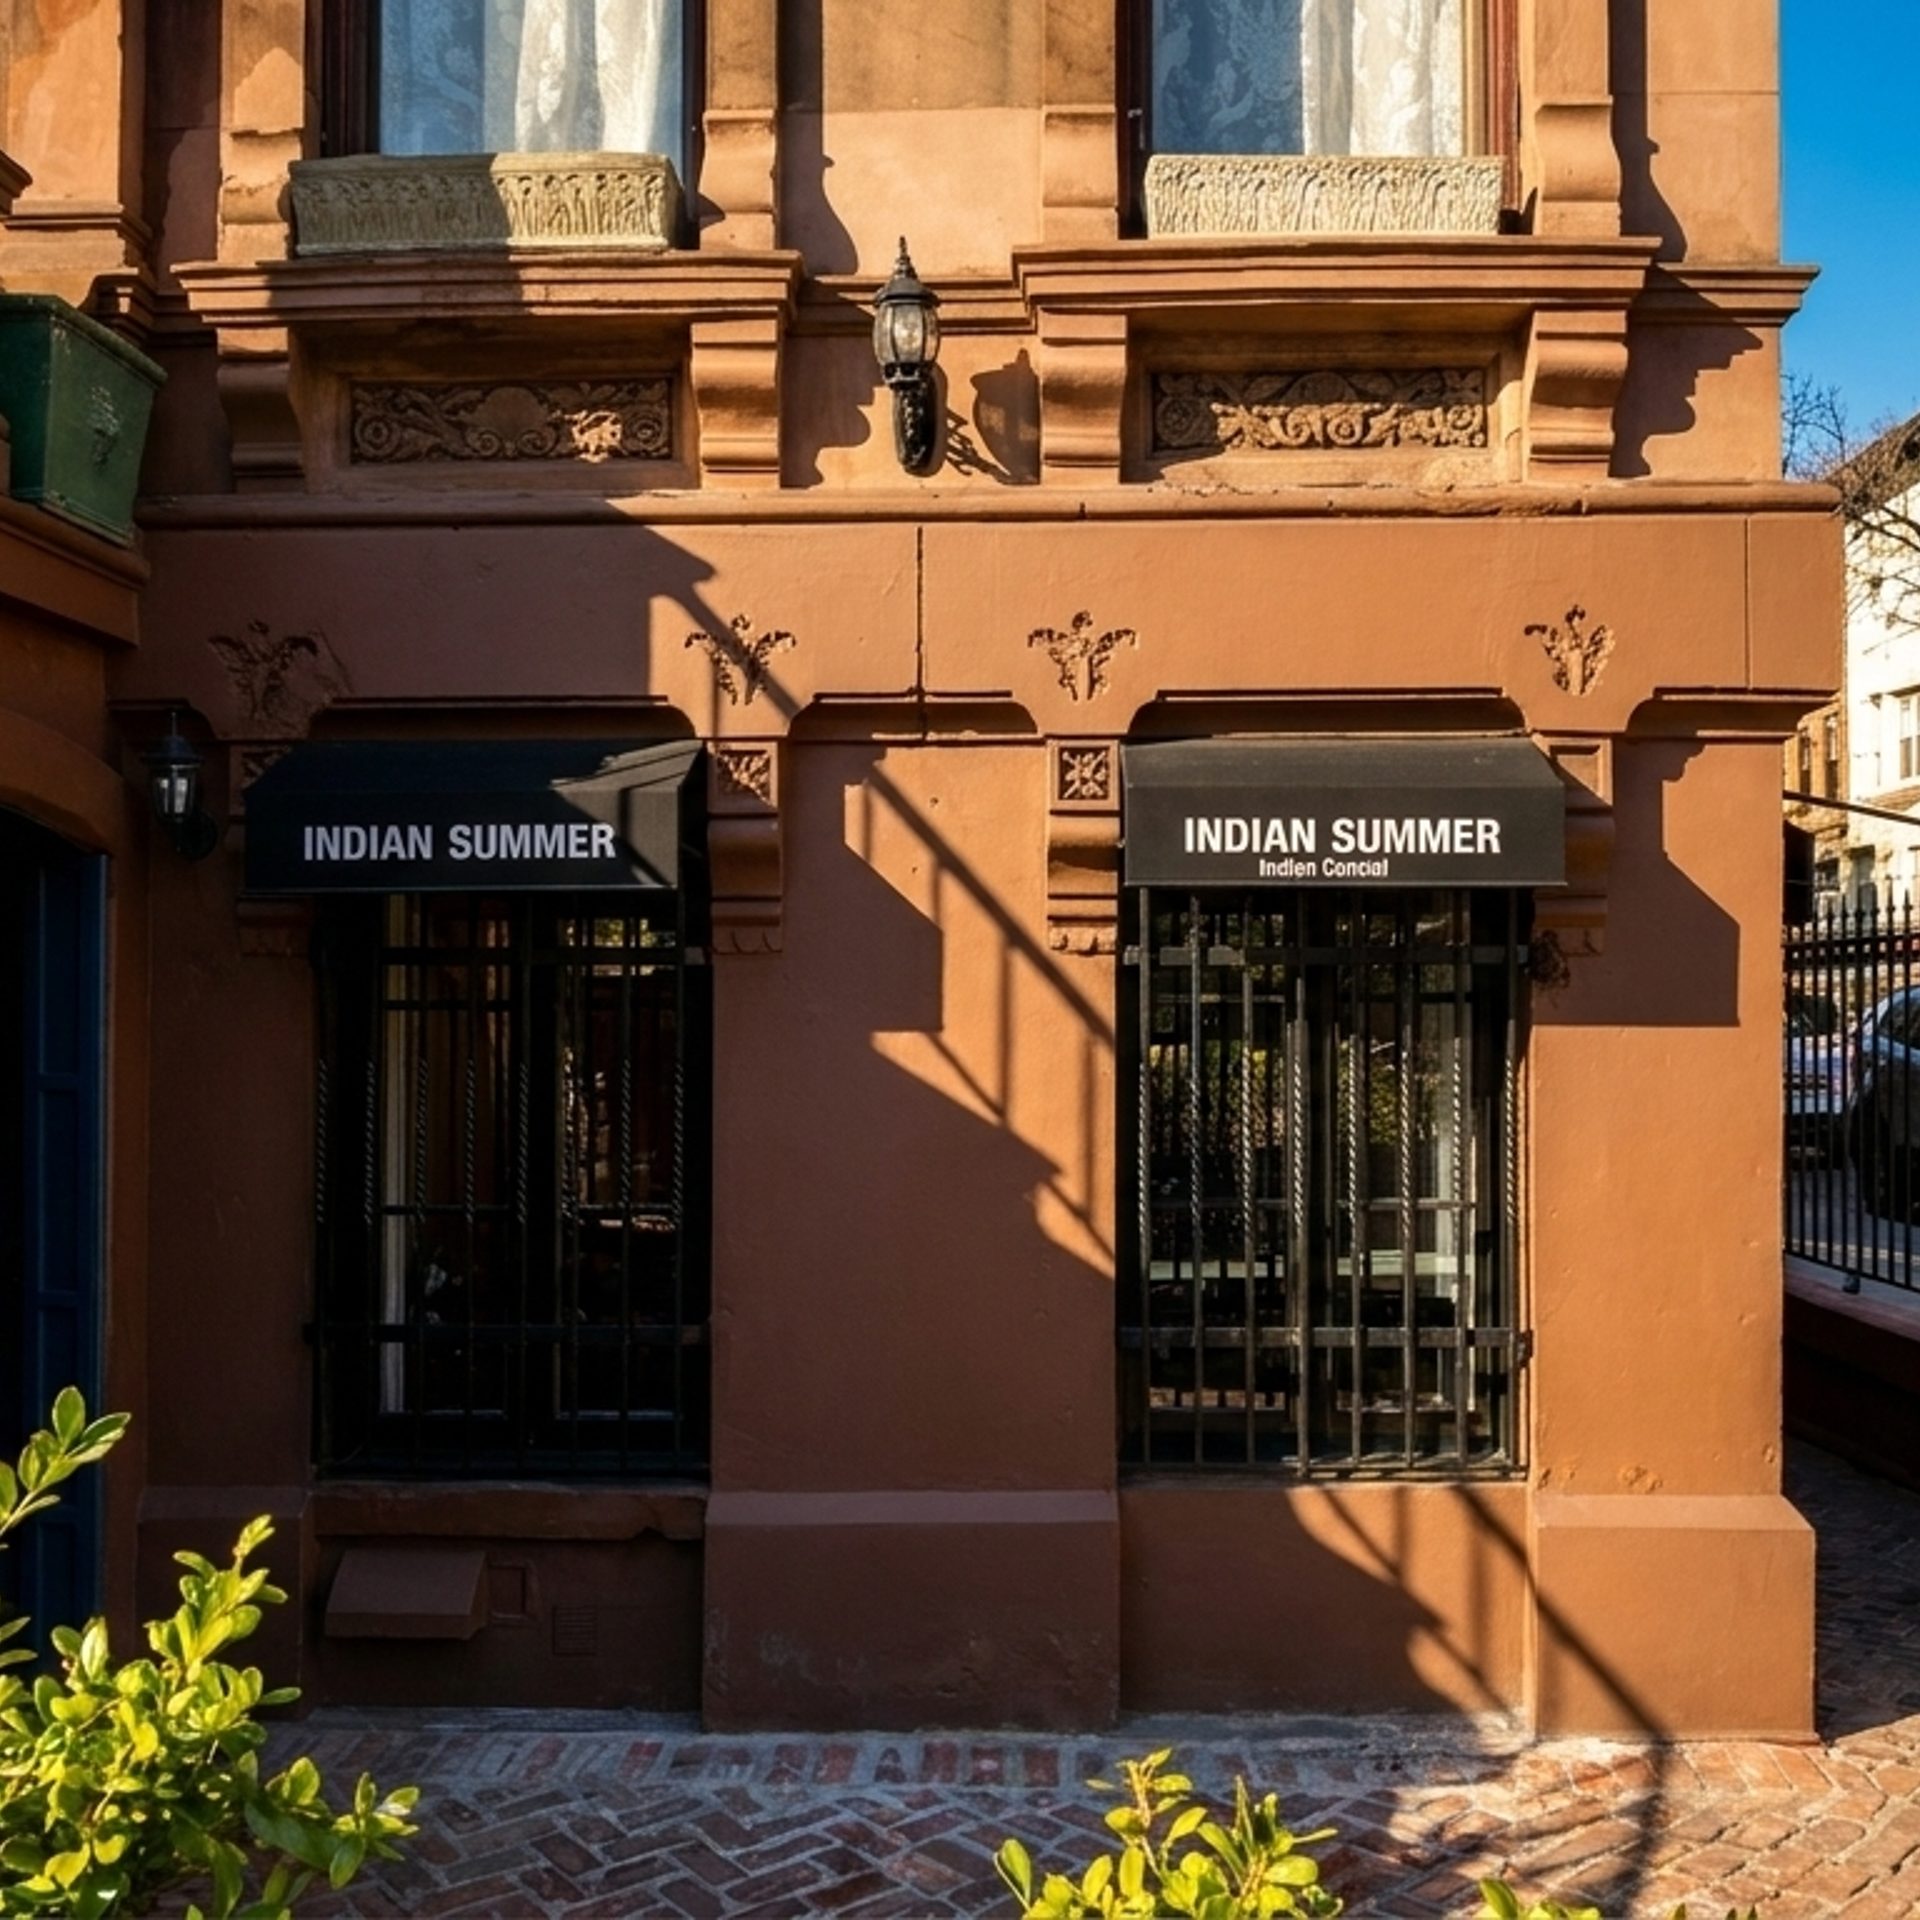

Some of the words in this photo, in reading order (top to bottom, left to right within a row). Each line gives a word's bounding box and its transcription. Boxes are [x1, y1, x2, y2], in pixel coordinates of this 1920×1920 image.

[304, 825, 433, 860] INDIAN
[448, 823, 616, 859] SUMMER
[1184, 817, 1316, 854] INDIAN
[1331, 817, 1501, 854] SUMMER
